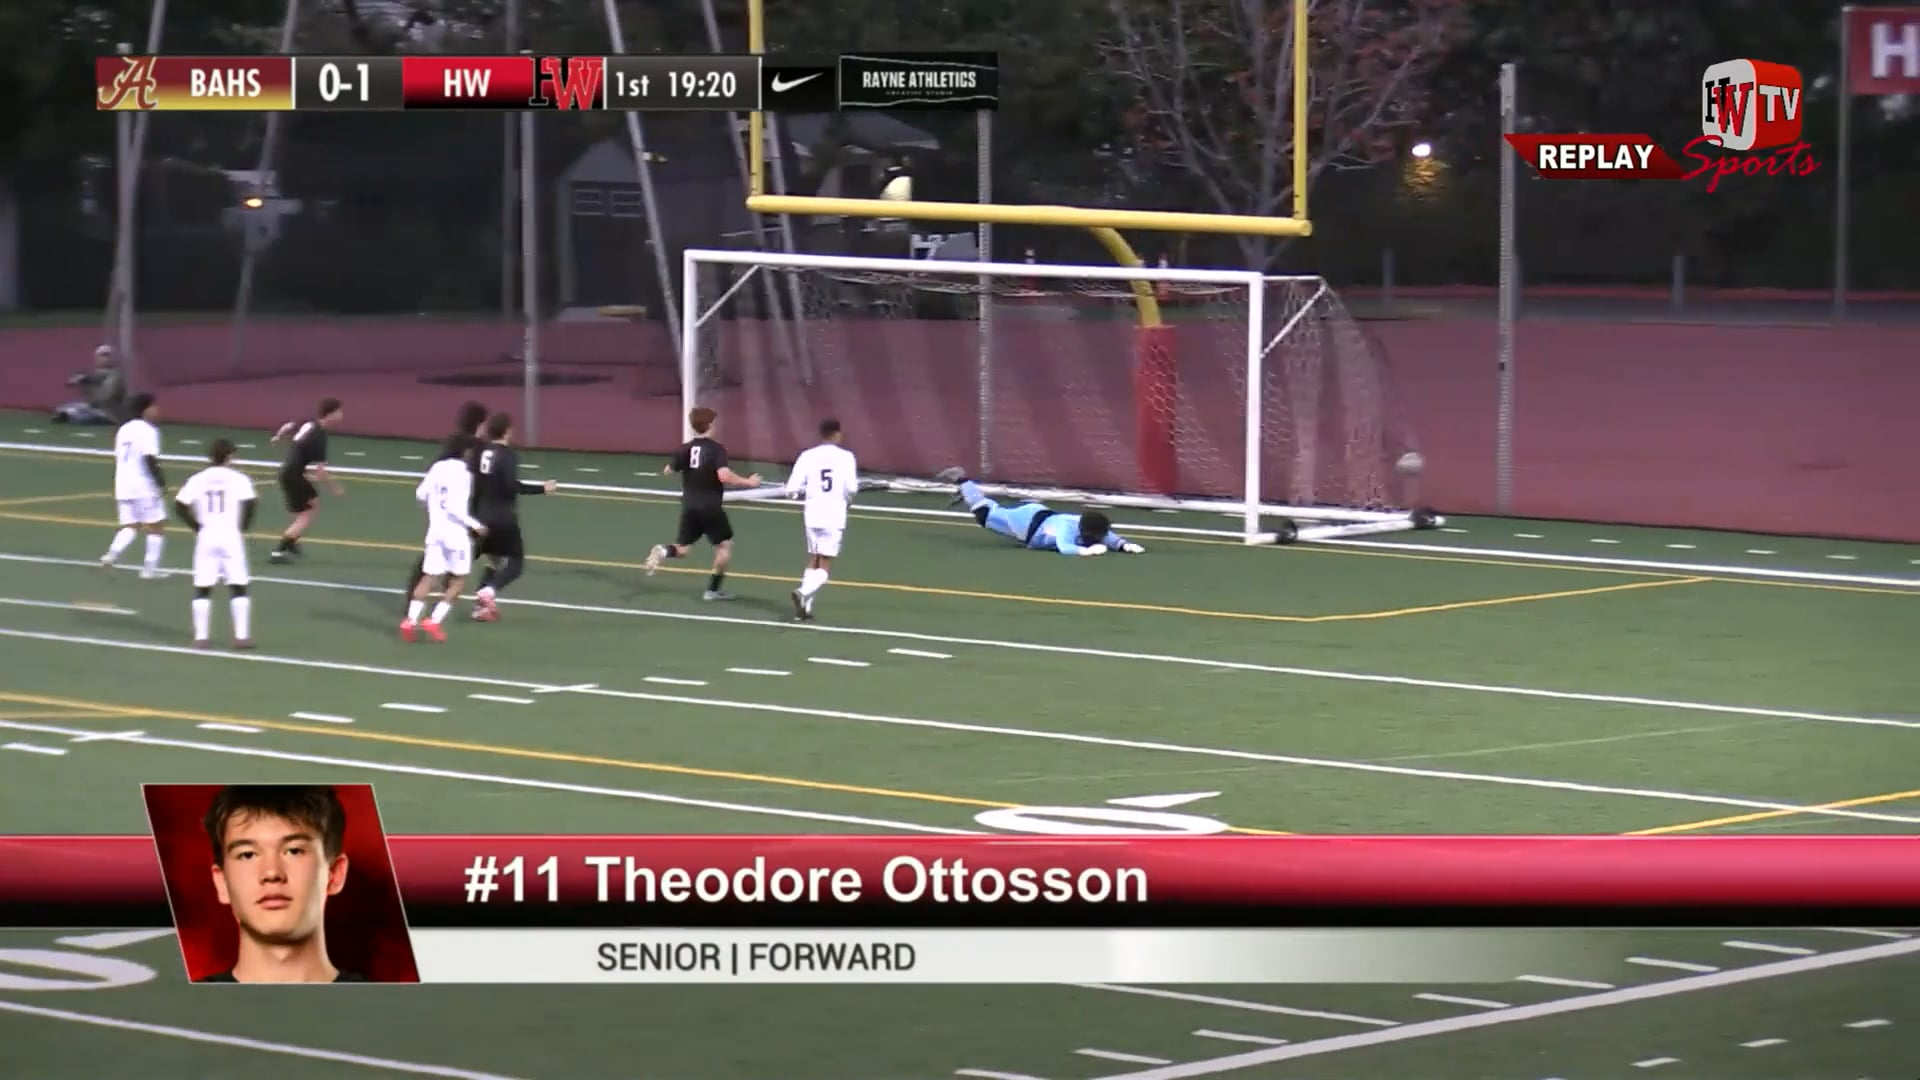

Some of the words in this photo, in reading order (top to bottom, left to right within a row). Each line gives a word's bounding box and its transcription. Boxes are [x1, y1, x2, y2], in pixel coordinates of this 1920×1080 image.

[480, 449, 495, 474] 6
[689, 446, 701, 468] 8
[820, 469, 833, 493] 5
[205, 489, 225, 513] 11
